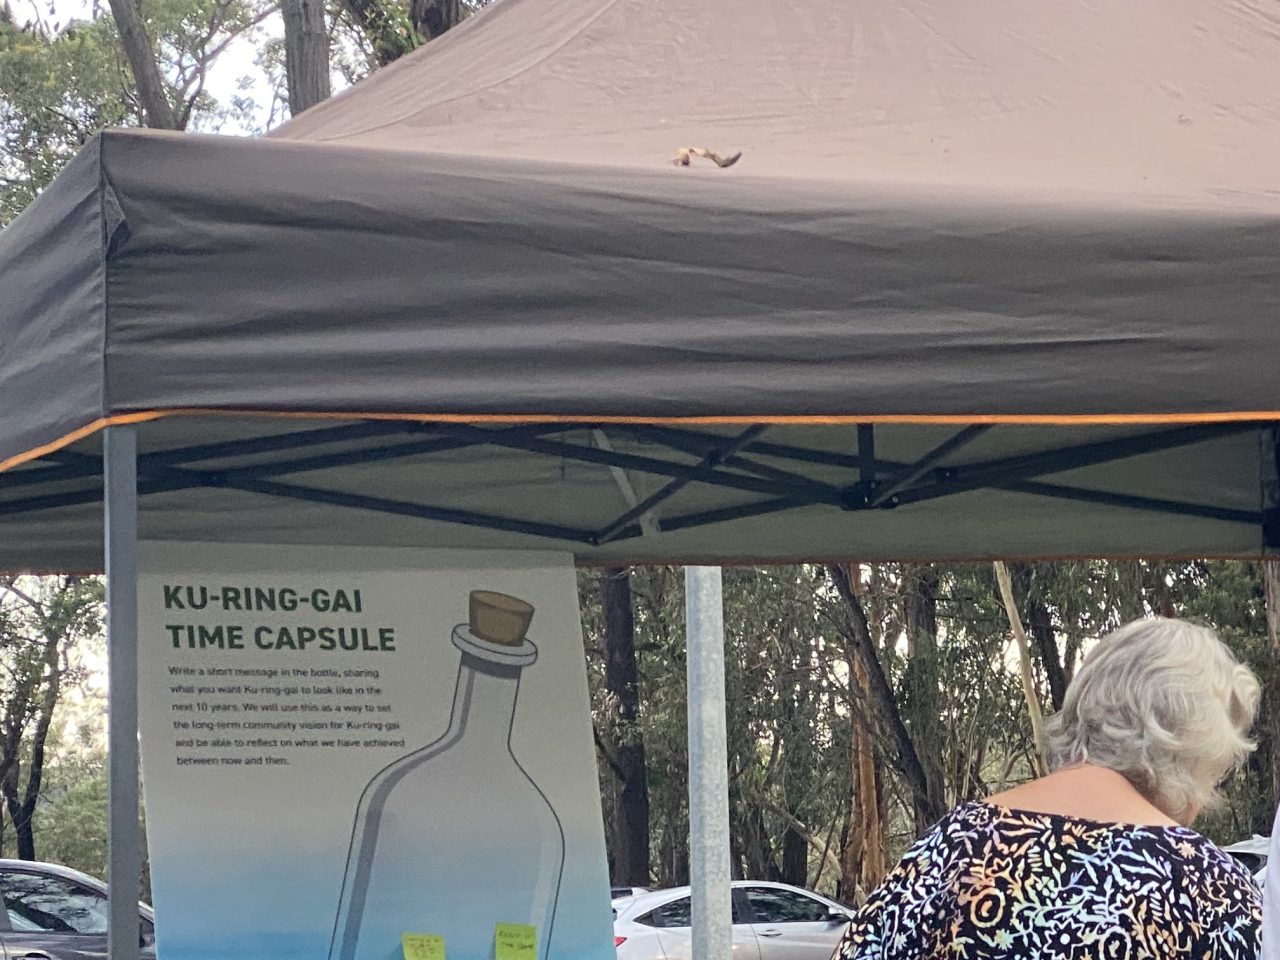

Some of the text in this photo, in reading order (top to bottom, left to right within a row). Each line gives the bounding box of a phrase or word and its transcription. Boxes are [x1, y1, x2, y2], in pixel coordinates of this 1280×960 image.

[163, 585, 362, 612] KU-RING-GAI
[165, 625, 396, 651] TIME CAPSULE
[168, 666, 380, 679] Write a short message in the bottle, sharing
[169, 684, 382, 696] what you want Ku-ring-gai to look like in the
[172, 703, 193, 711] next
[196, 702, 208, 711] 10
[242, 703, 259, 712] We
[260, 703, 278, 712] will
[281, 704, 299, 712] use
[300, 704, 319, 712] this
[321, 704, 333, 712] as
[343, 705, 362, 714] way
[365, 704, 375, 712] to
[377, 704, 392, 712] set
[173, 721, 189, 729] the
[243, 721, 297, 731] community
[299, 721, 328, 730] vision
[330, 721, 344, 730] for
[346, 721, 400, 731] Ku-ring-gai
[175, 739, 193, 747] and
[196, 739, 208, 747] be
[211, 739, 232, 747] able
[234, 739, 244, 747] to
[246, 738, 278, 747] reflect
[295, 739, 318, 747] what
[337, 739, 361, 747] have
[363, 739, 405, 747] achieved
[176, 757, 218, 765] between
[244, 757, 263, 765] and
